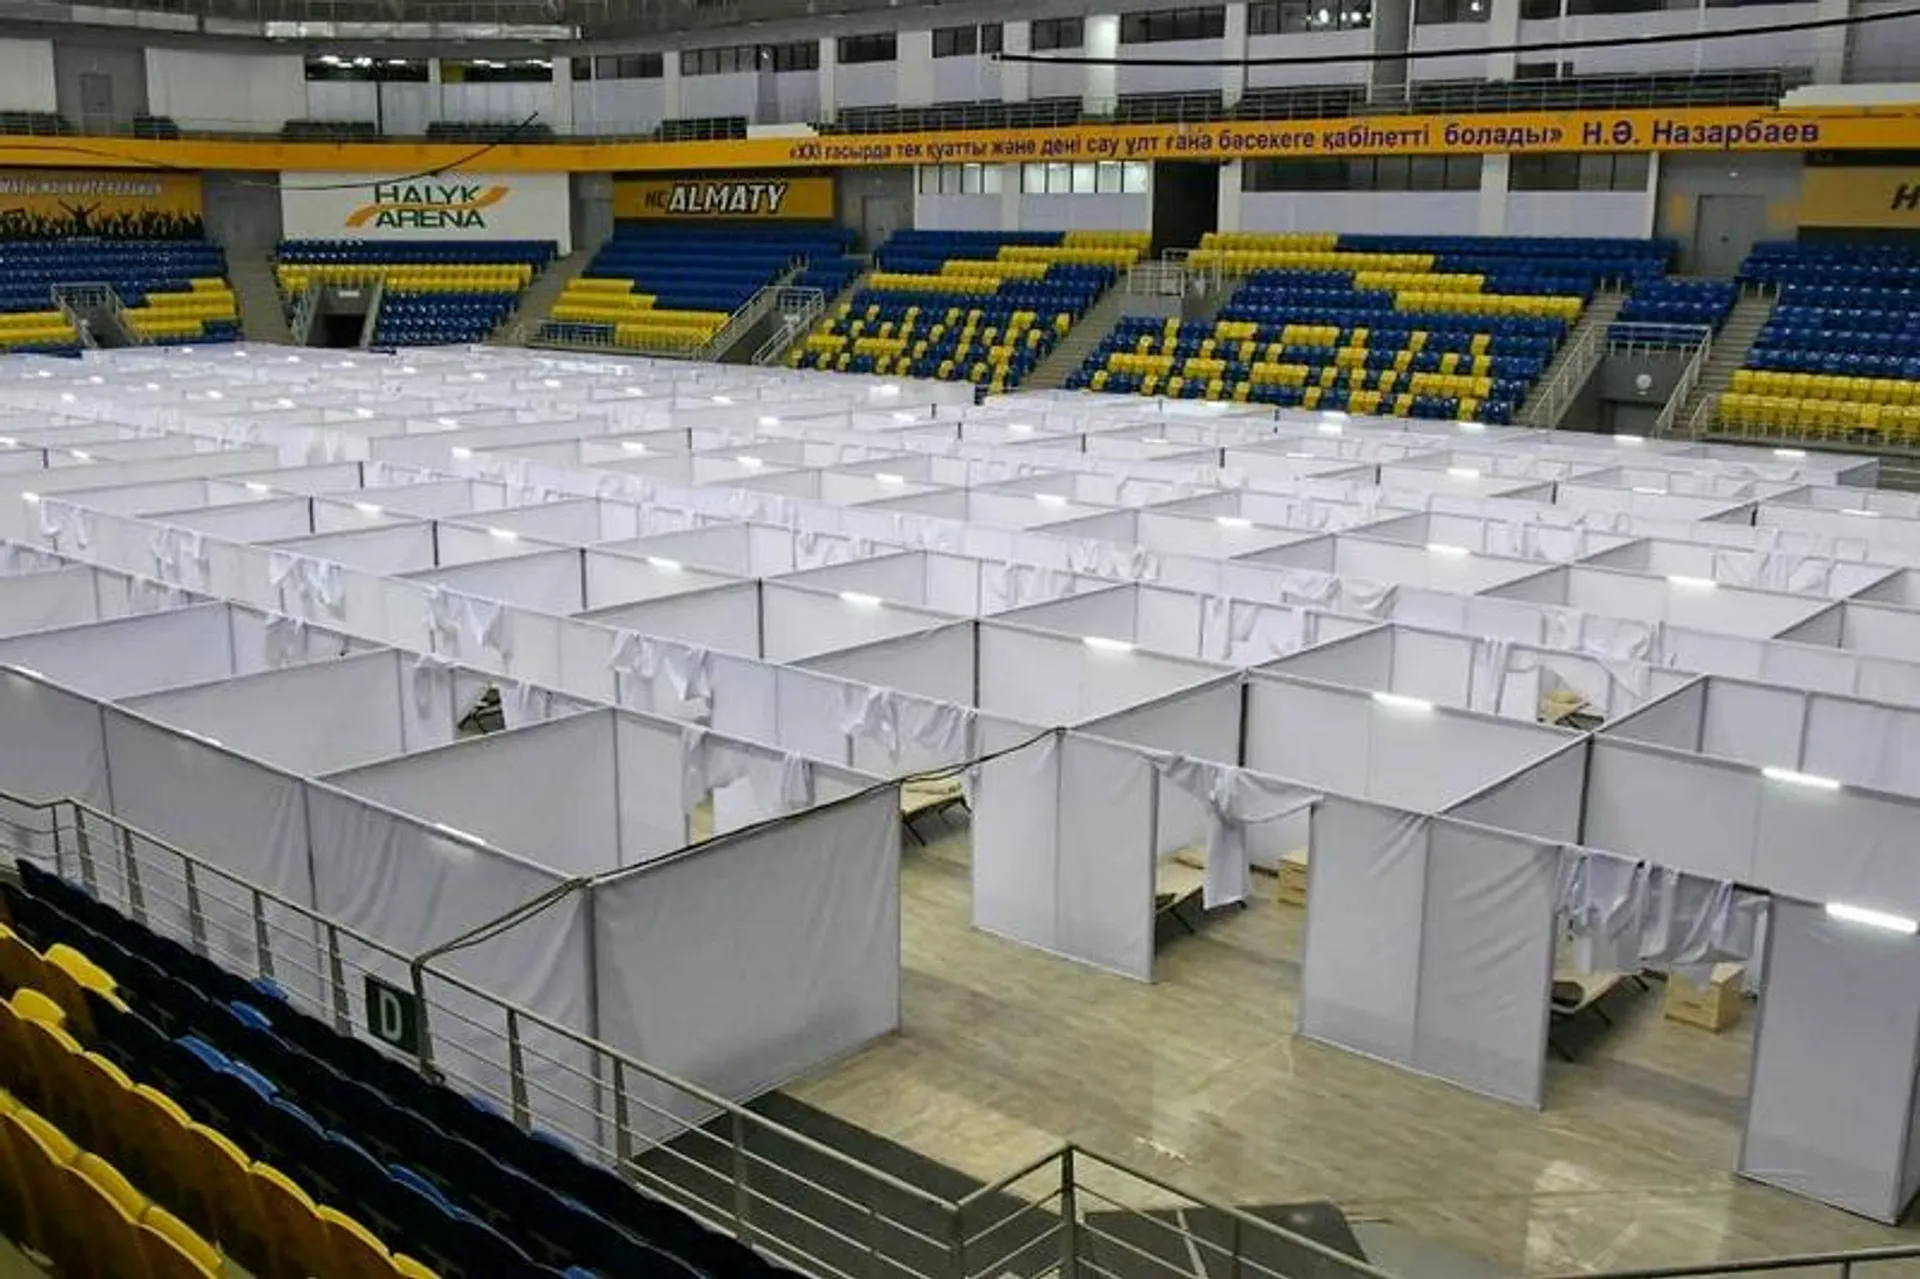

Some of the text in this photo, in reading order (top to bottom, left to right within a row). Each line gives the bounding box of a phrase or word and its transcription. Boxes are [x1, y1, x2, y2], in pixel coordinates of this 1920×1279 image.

[1086, 136, 1120, 157] сау
[1443, 123, 1564, 147] болады»
[1653, 119, 1820, 149] Назарбаев
[373, 183, 481, 205] HALYK
[668, 182, 787, 214] ALMATY
[375, 209, 486, 229] ARENA
[379, 987, 402, 1042] D
